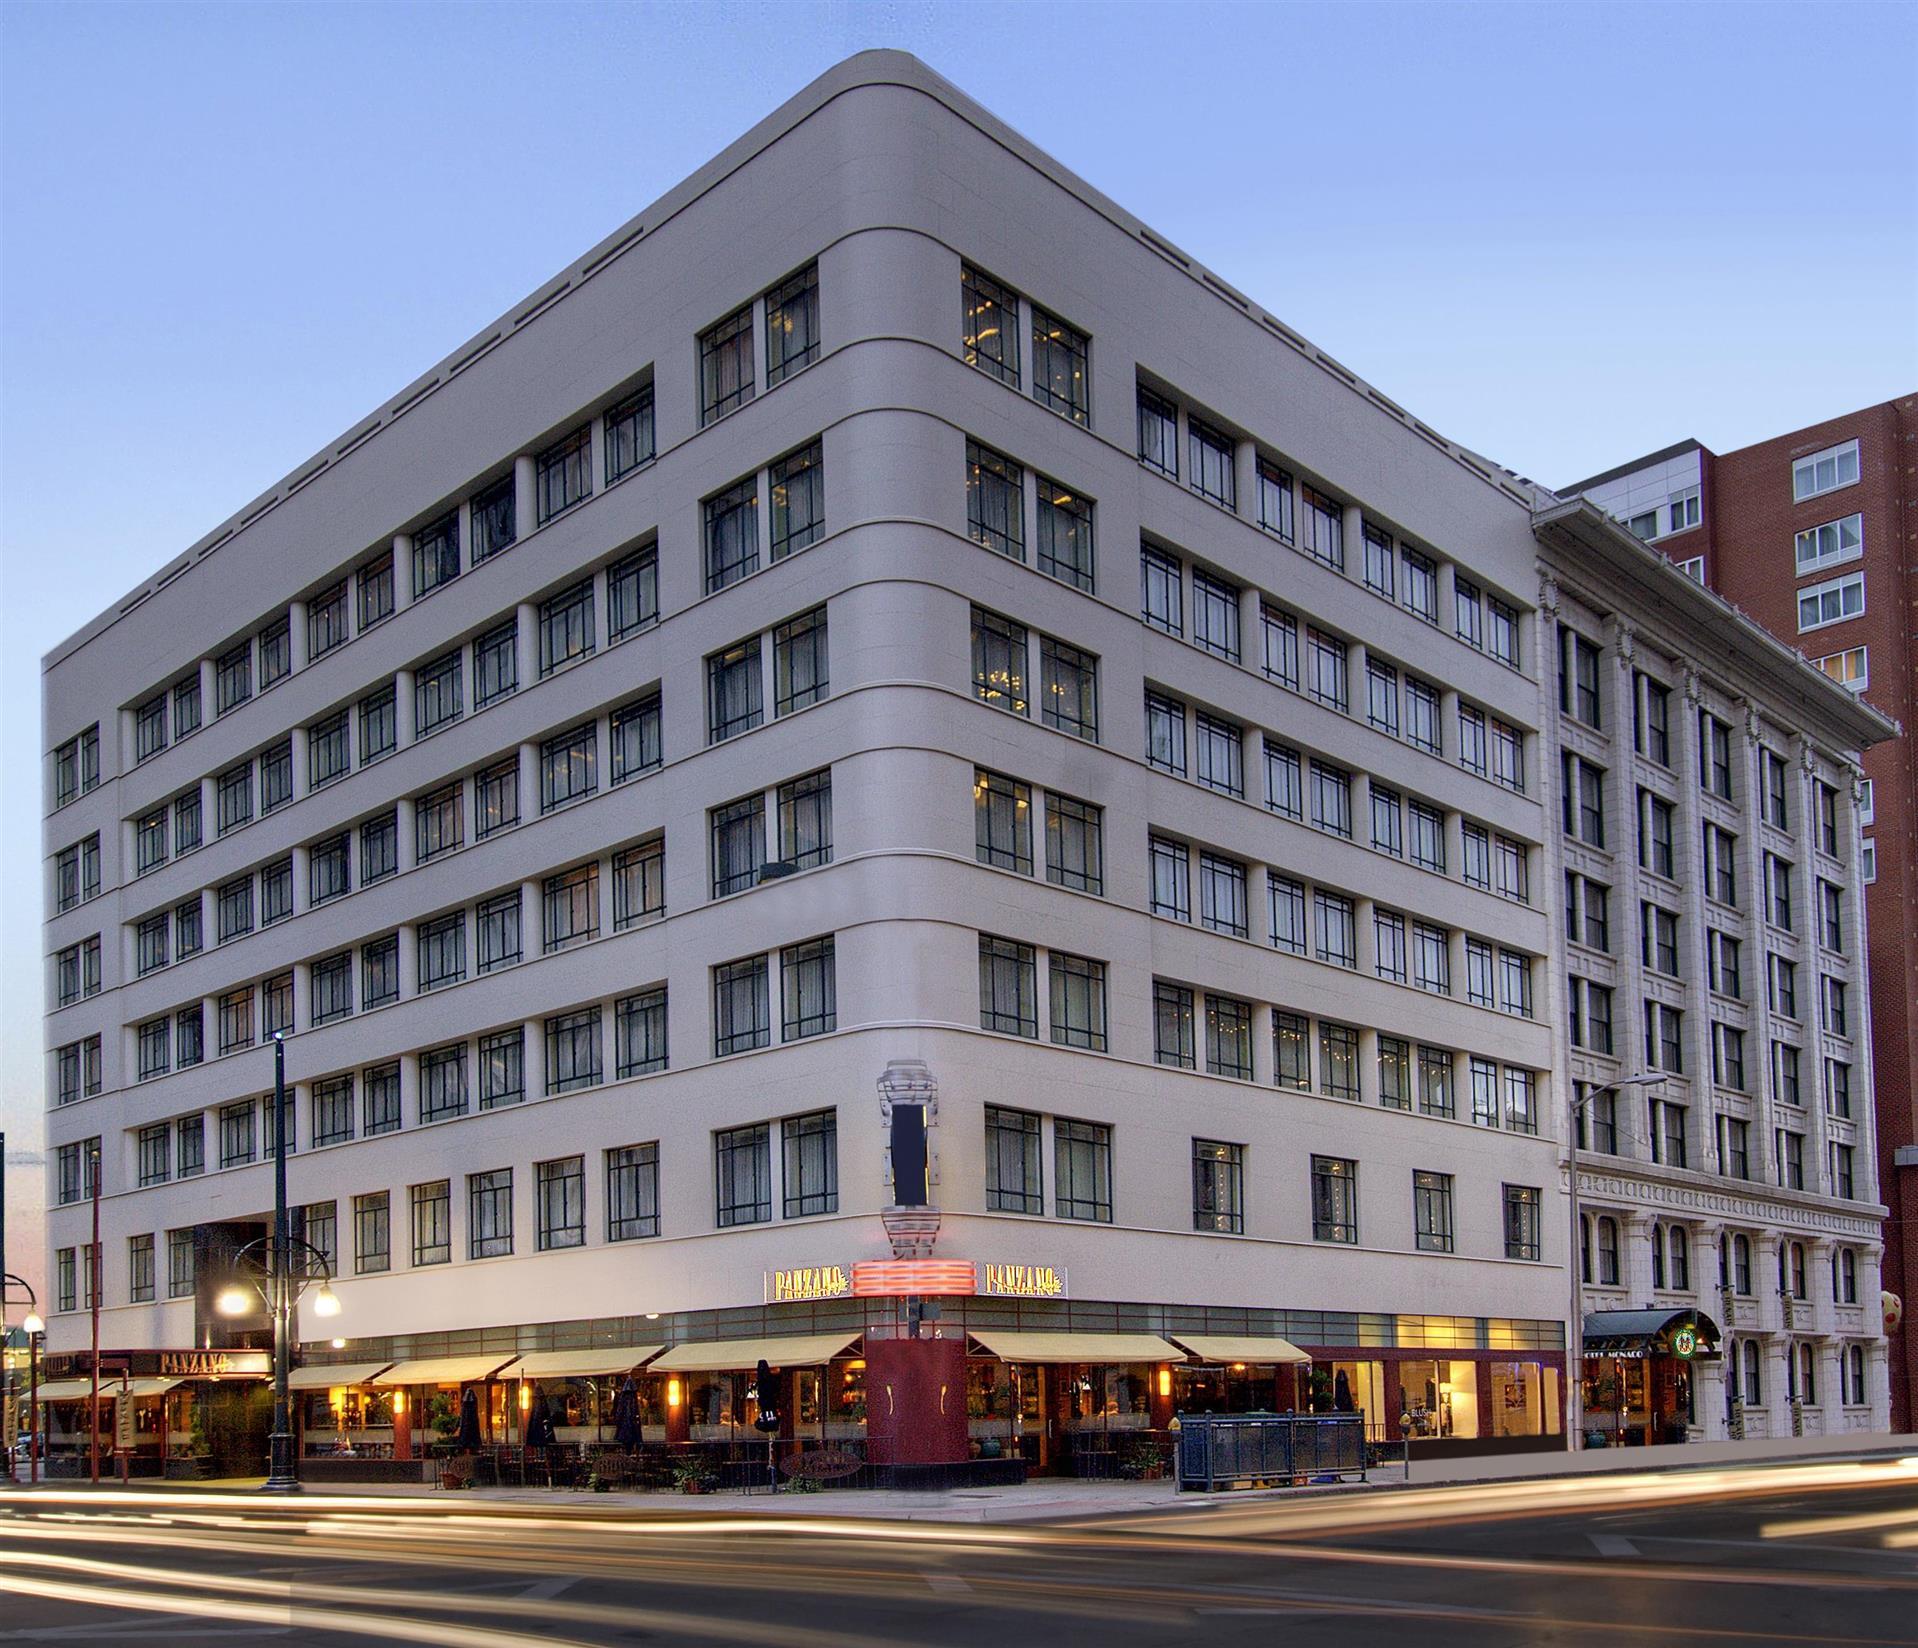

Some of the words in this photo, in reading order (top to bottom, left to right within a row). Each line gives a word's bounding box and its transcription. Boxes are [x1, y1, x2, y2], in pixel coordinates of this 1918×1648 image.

[775, 1266, 841, 1301] PANZANO
[986, 1264, 1055, 1296] PANZANO
[161, 1353, 227, 1374] PANZANO
[1583, 1351, 1604, 1359] OTEL
[1608, 1350, 1643, 1359] MONACO
